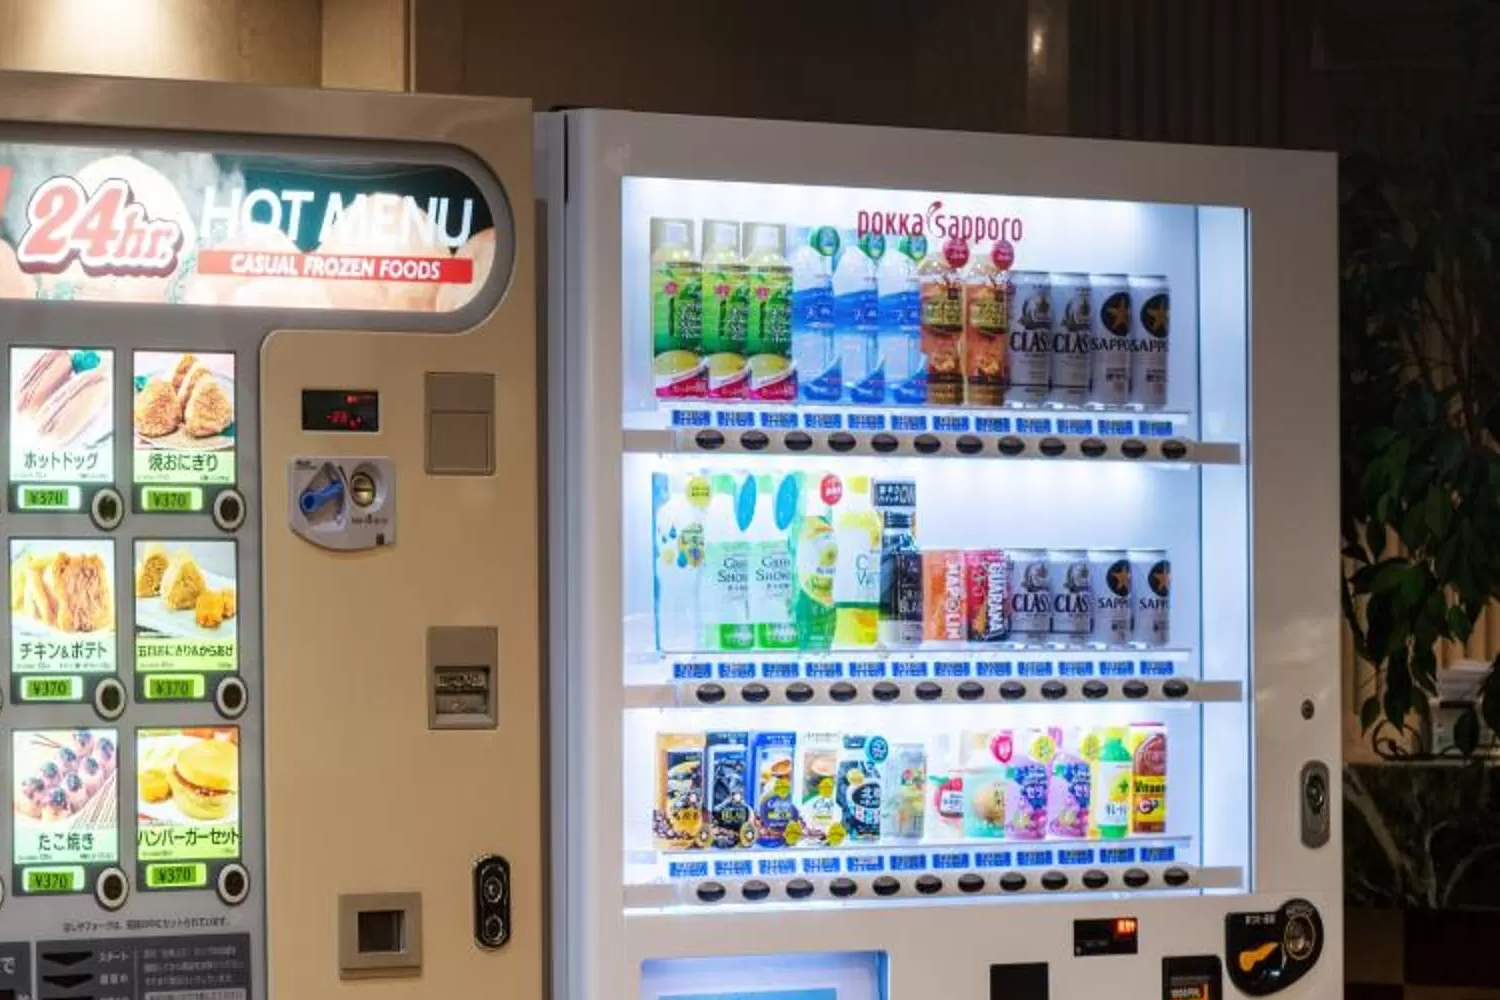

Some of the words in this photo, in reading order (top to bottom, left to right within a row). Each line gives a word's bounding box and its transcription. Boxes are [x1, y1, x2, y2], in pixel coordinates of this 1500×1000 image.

[201, 189, 315, 243] HOT
[318, 192, 473, 248] MENU
[230, 253, 298, 278] CASUAL
[302, 255, 377, 279] FROZEN
[380, 257, 441, 281] FOODS
[24, 450, 98, 471] ホットドッグ
[147, 451, 219, 472] 焼おにぎり
[38, 831, 96, 852] たこ焼き
[137, 827, 240, 848] ハンバーガーセット
[33, 872, 68, 889] ¥370
[156, 866, 191, 884] ¥370
